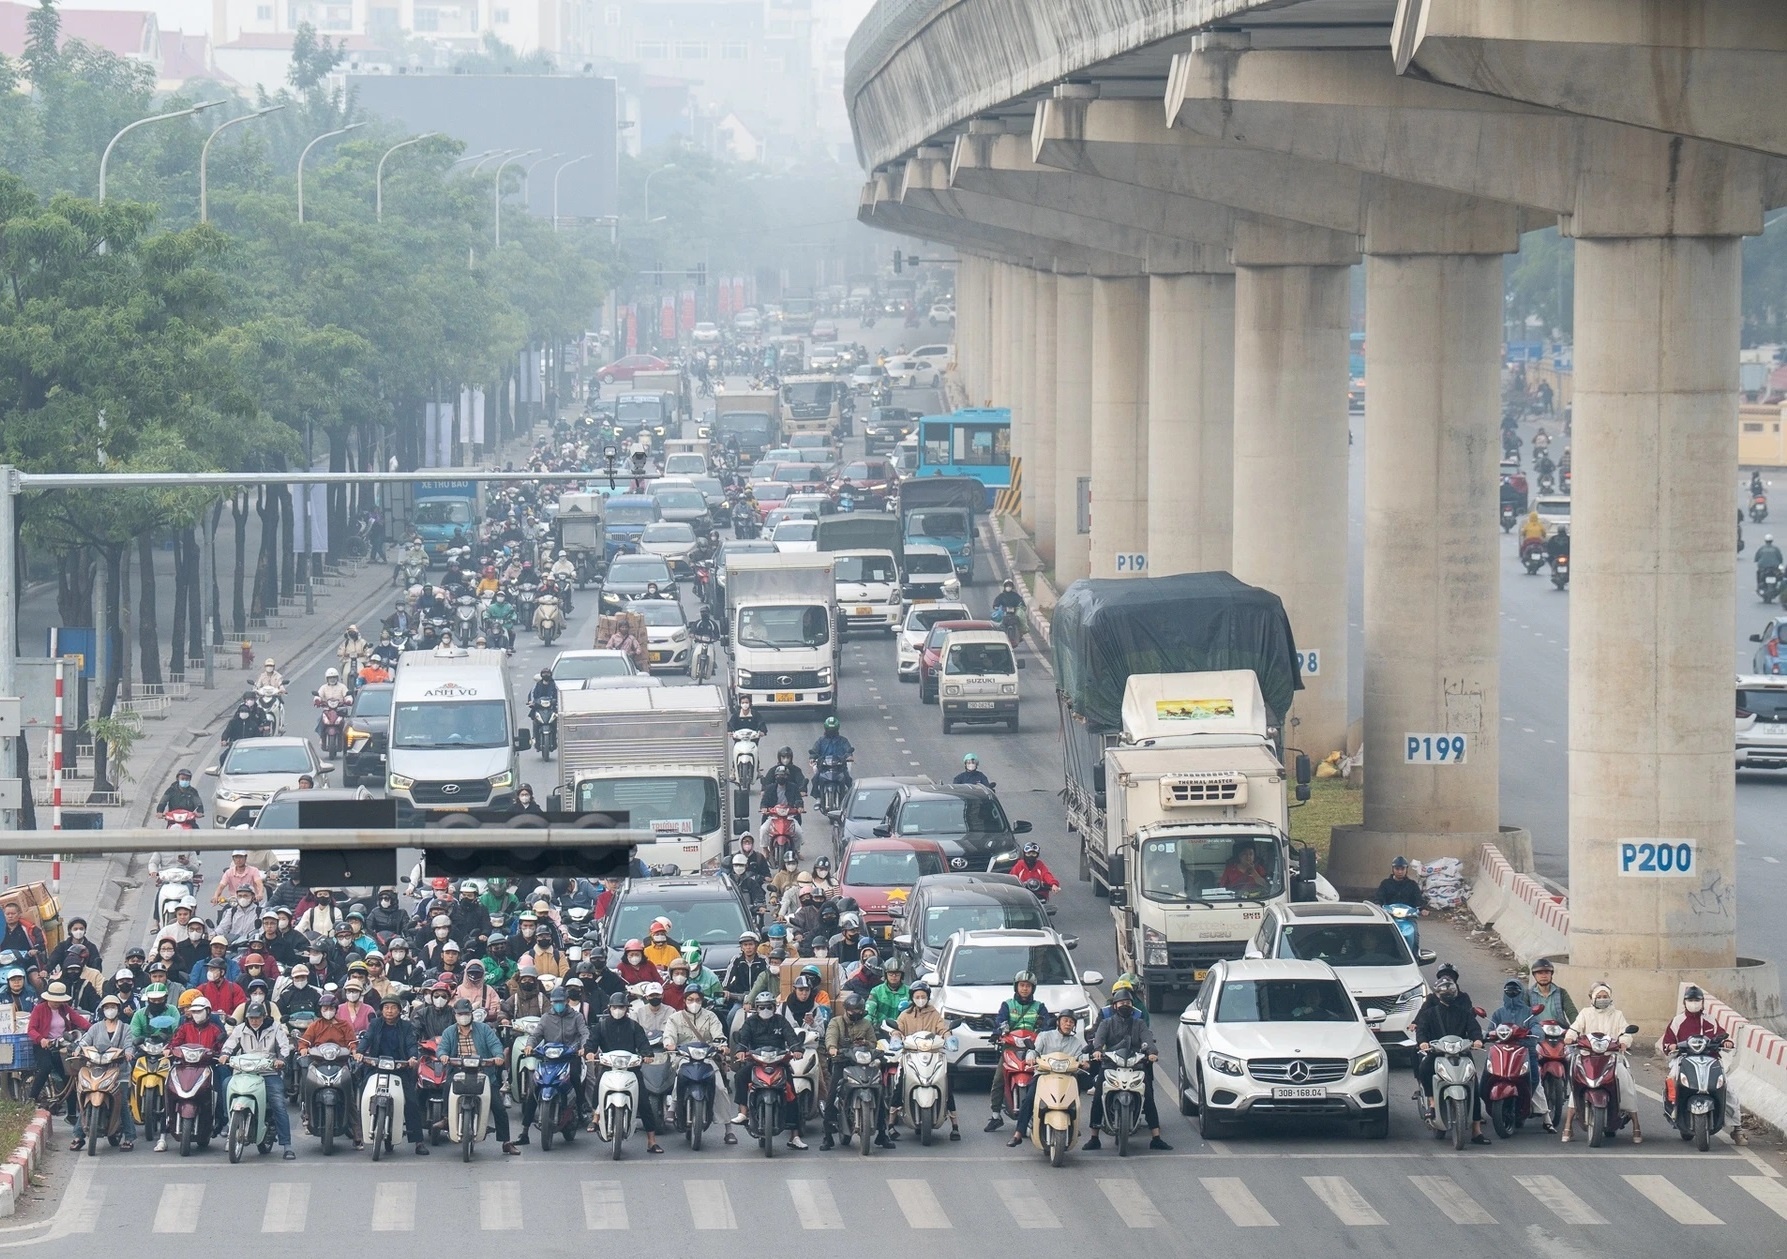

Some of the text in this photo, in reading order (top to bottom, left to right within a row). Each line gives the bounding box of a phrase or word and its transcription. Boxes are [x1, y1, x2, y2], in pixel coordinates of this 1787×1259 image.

[1117, 554, 1149, 571] P19
[424, 689, 454, 697] ANH
[1407, 736, 1465, 761] P199
[681, 821, 692, 833] AN
[1622, 843, 1691, 871] P200
[1199, 931, 1232, 939] ISUZU
[1278, 1089, 1322, 1097] 30B-168.04
